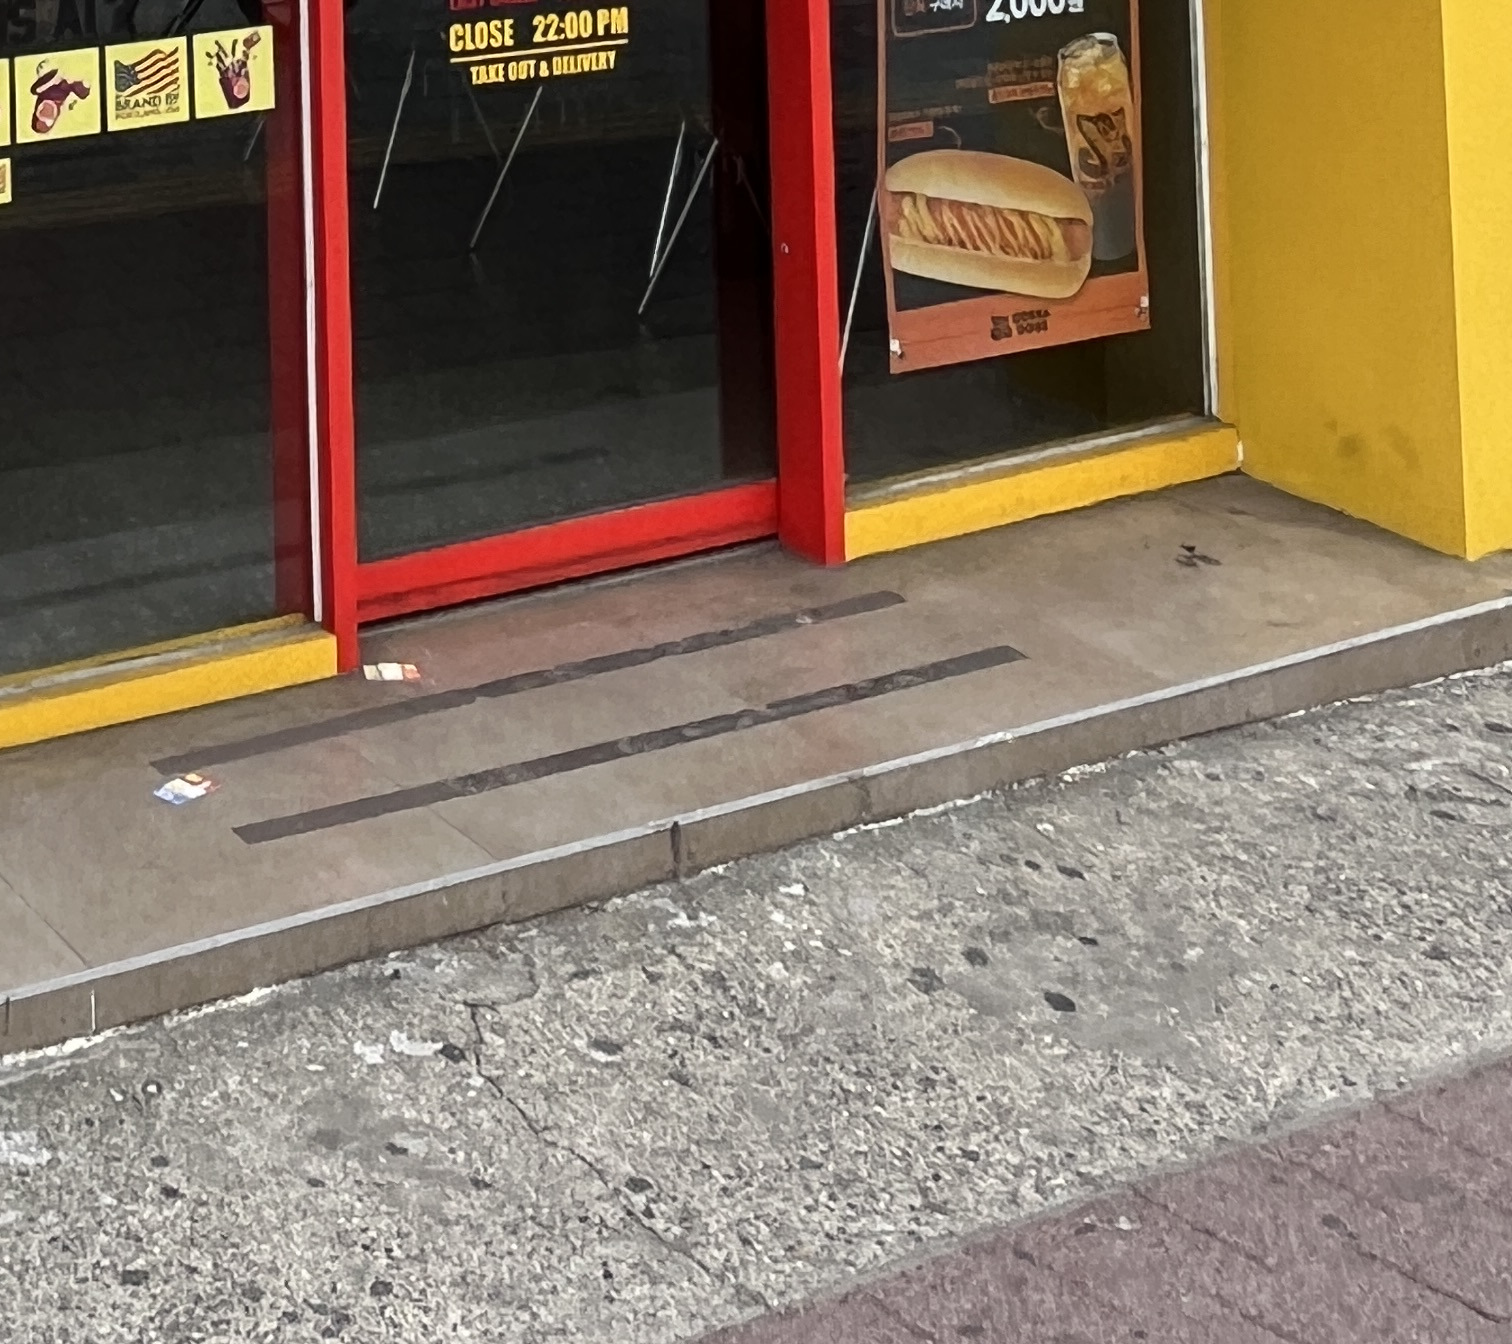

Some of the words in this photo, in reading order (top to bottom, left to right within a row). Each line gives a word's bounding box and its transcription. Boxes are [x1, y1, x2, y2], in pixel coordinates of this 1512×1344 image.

[449, 19, 515, 52] CLOSE
[532, 10, 593, 43] 22:00
[596, 6, 629, 36] PM
[469, 62, 505, 85] TAKE
[507, 59, 537, 81] OUT
[552, 50, 617, 76] DELIVERY
